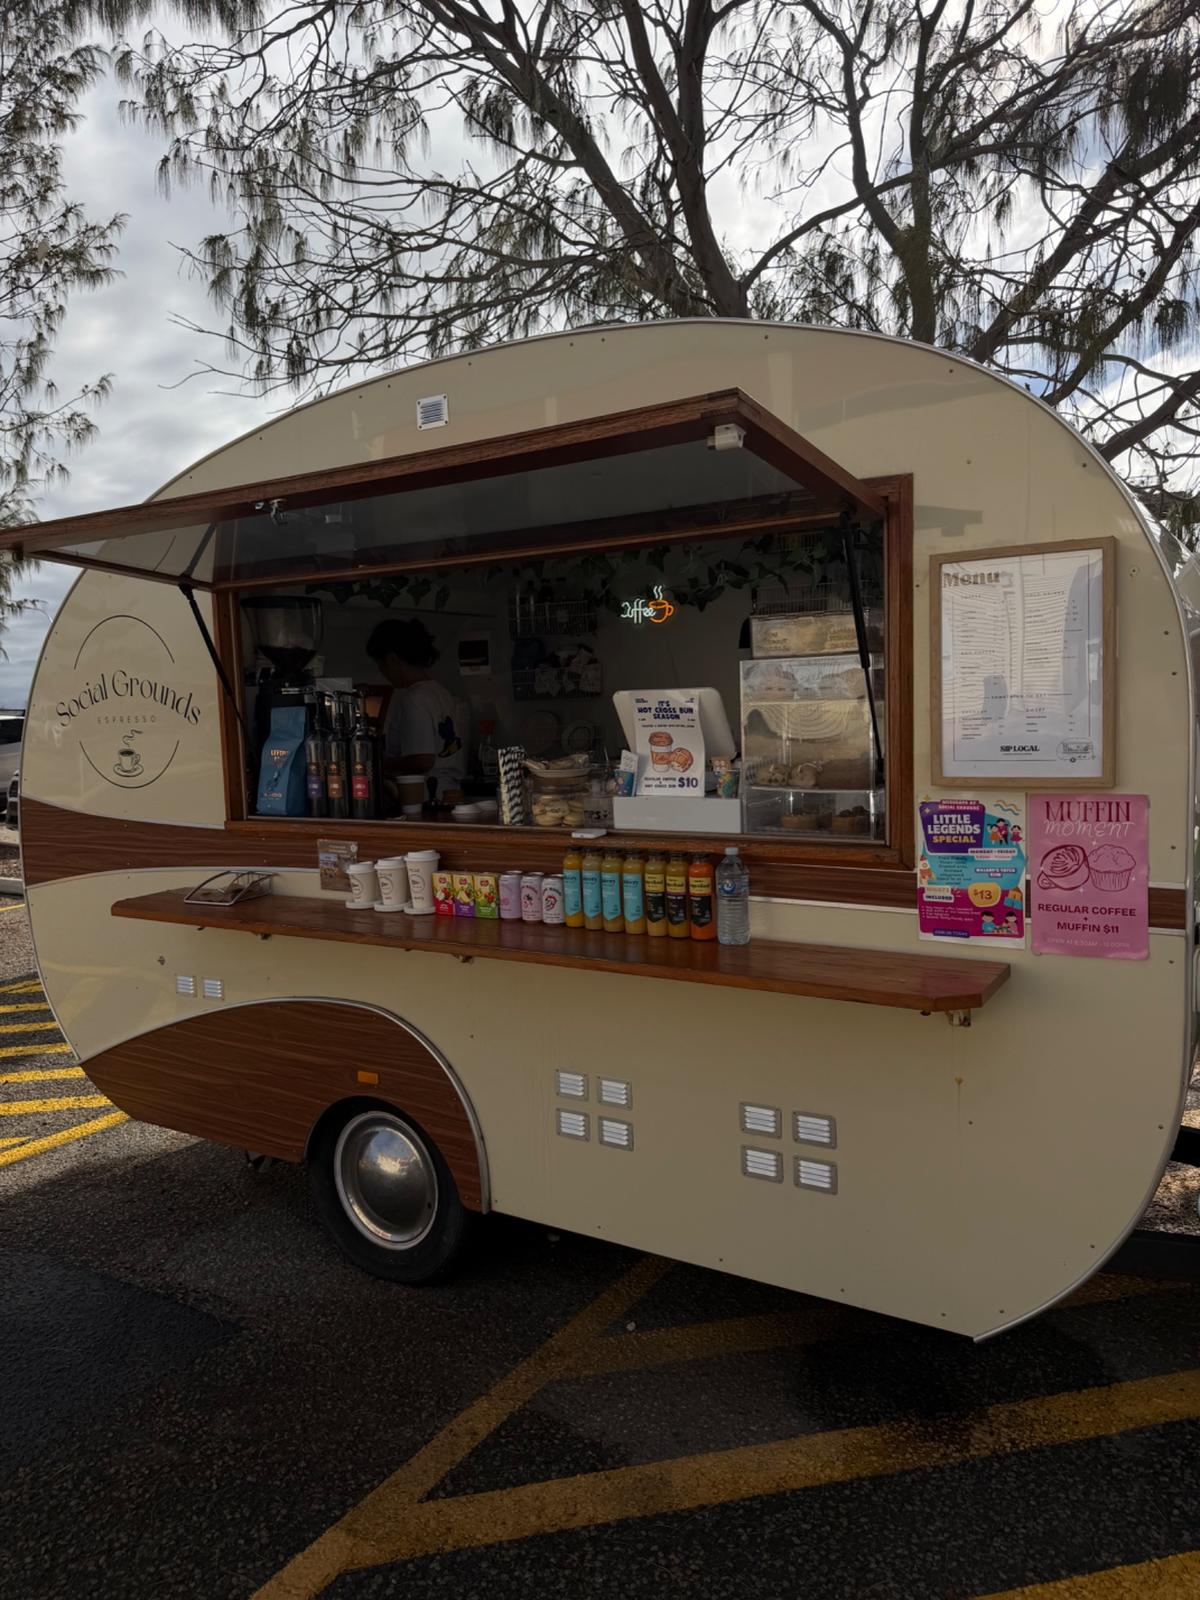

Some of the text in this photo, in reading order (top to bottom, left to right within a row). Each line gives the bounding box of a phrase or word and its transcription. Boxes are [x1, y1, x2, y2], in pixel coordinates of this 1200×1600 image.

[943, 571, 1001, 588] Menu
[56, 670, 201, 727] Social Grounds
[657, 700, 671, 708] IT'S
[637, 707, 694, 716] HOT CROSS BUN
[653, 713, 680, 721] SEASON
[97, 715, 157, 724] ESPRESSO
[1013, 745, 1040, 753] LOCAL
[678, 777, 699, 788] $10
[1045, 801, 1131, 822] MUFFIN
[933, 814, 972, 825] LITTLE
[927, 824, 983, 836] LEGENDS
[1043, 819, 1136, 838] MOMENT
[932, 835, 977, 844] SPECIAL
[973, 888, 993, 901] $13
[1037, 903, 1137, 916] REGULAR COFFEE
[1056, 921, 1120, 935] MUFFIN $11
